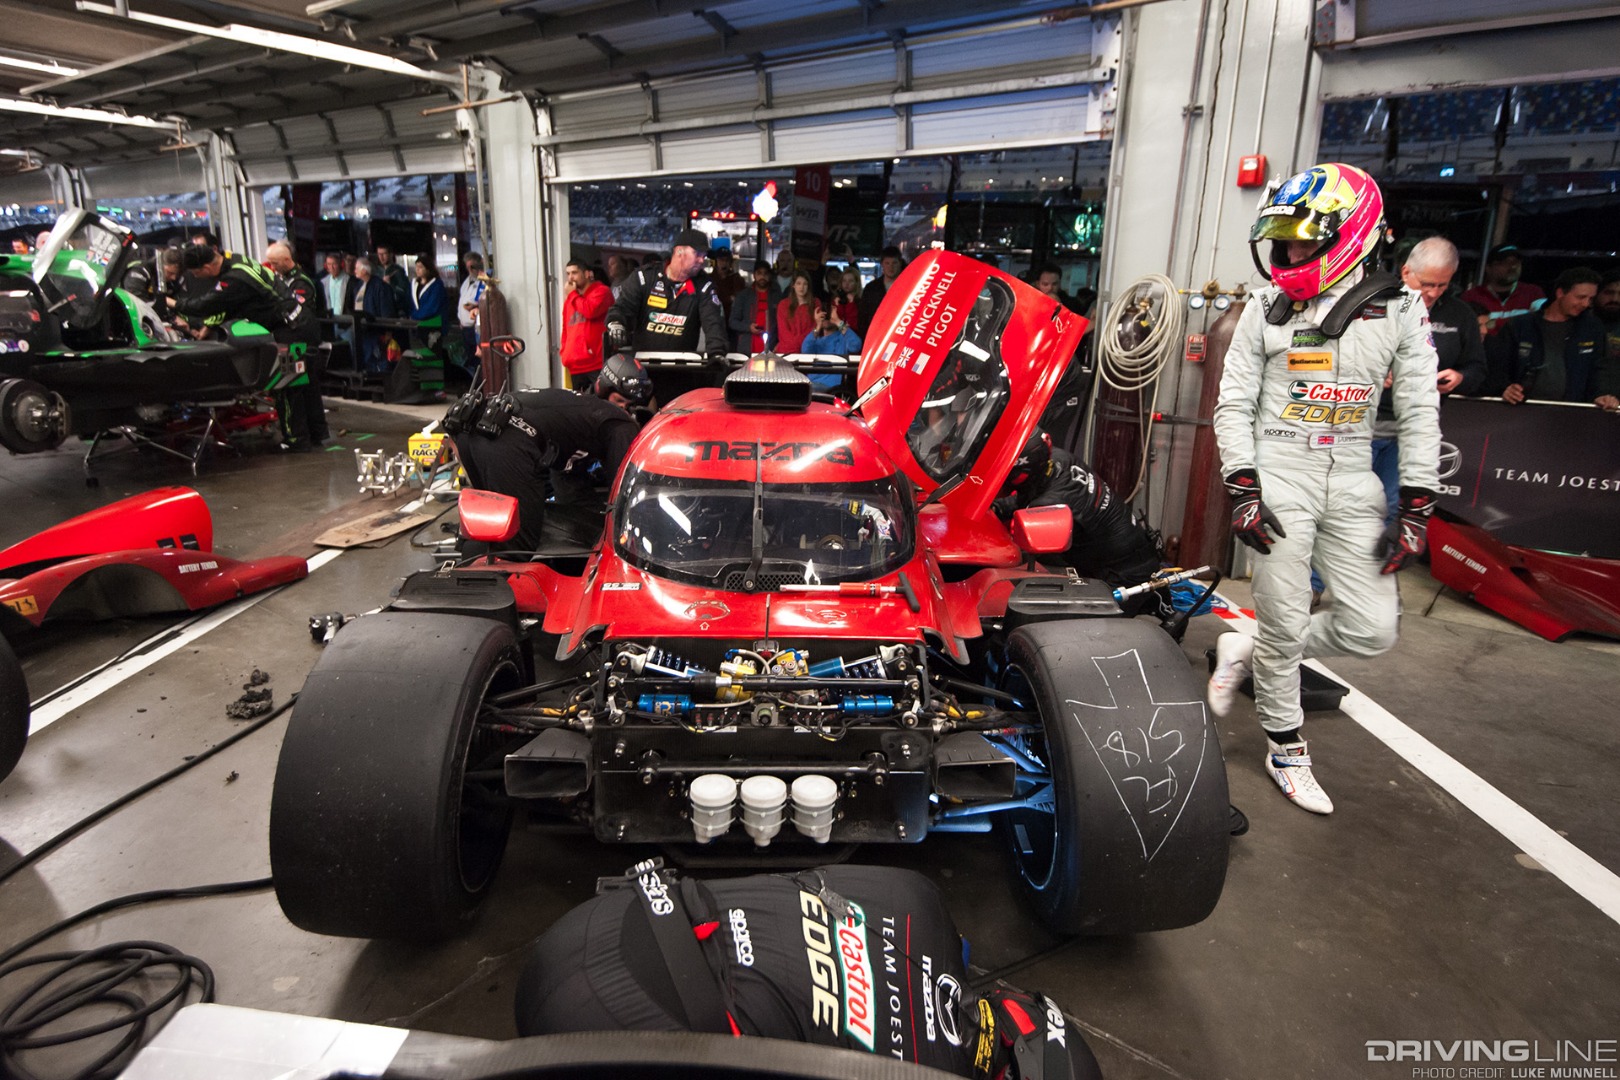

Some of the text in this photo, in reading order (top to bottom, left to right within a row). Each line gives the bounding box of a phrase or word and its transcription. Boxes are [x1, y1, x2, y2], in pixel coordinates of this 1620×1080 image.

[804, 171, 821, 192] 10
[910, 271, 957, 339] TINCKNELL
[646, 322, 685, 336] EDGE
[657, 313, 685, 325] Castrol
[926, 303, 957, 347] PIGOT
[603, 365, 618, 385] uvex
[1309, 383, 1374, 403] Castrol
[1279, 402, 1371, 425] EDGE
[1263, 428, 1296, 438] sparco
[1495, 467, 1620, 492] TEAM JOEST
[178, 560, 218, 574] BATTERY TENDER
[1441, 544, 1488, 575] BATTERY TENDER
[729, 908, 754, 967] sparco
[799, 889, 839, 1037] EDGE
[839, 928, 871, 1036] Castrol
[882, 916, 904, 1062] TEAM JOEST
[921, 954, 937, 1042] mazda
